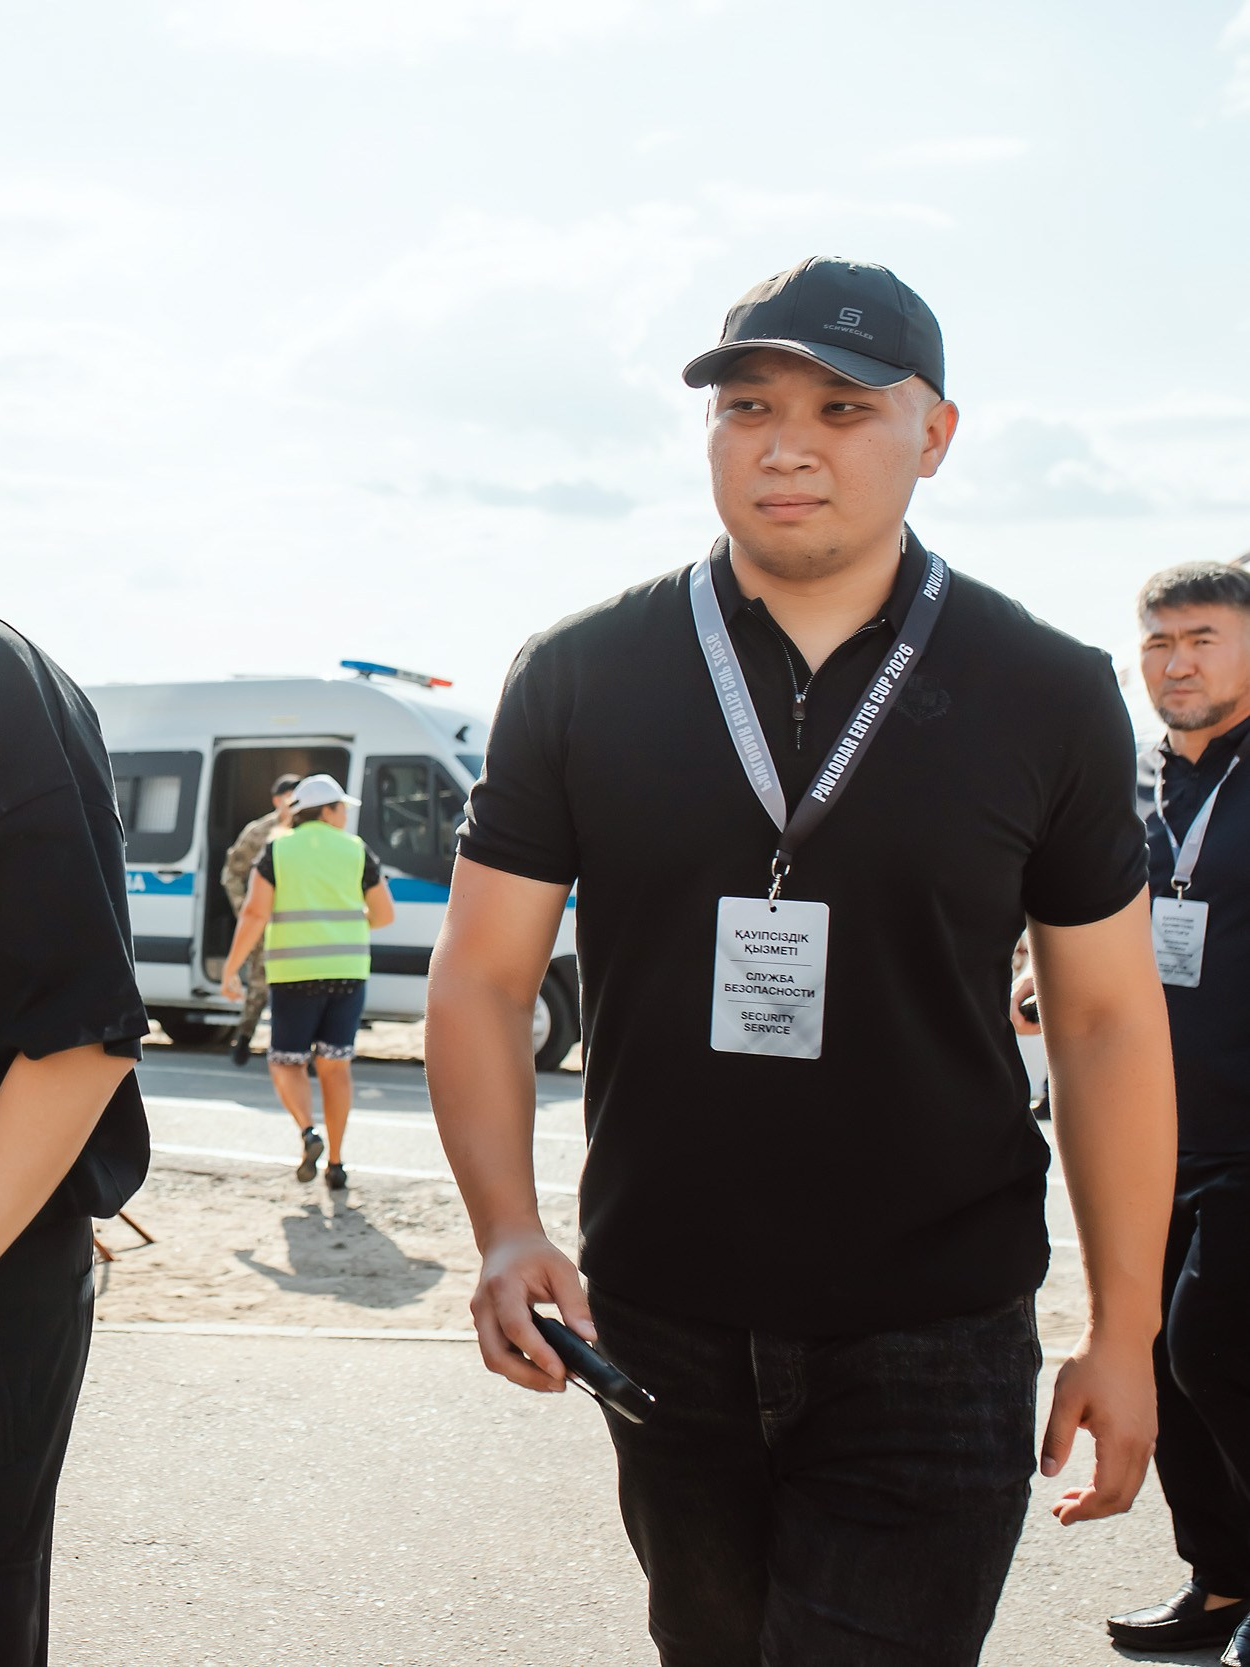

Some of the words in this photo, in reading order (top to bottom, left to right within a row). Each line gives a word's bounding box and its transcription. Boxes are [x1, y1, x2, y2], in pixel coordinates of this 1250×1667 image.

[811, 736, 860, 803] PAVLODAR
[848, 702, 880, 740] ERTIS
[869, 676, 894, 705] CUP
[884, 643, 914, 680] 2026
[735, 929, 809, 944] ҚАУІПСІЗДІК
[744, 944, 798, 956] ҚЫЗМЕТІ
[746, 972, 794, 983] СЛУЖБА
[724, 983, 815, 998] БЕЗОПАСНОСТИ
[741, 1011, 795, 1024] SECURITY
[743, 1023, 791, 1035] SERVICE
